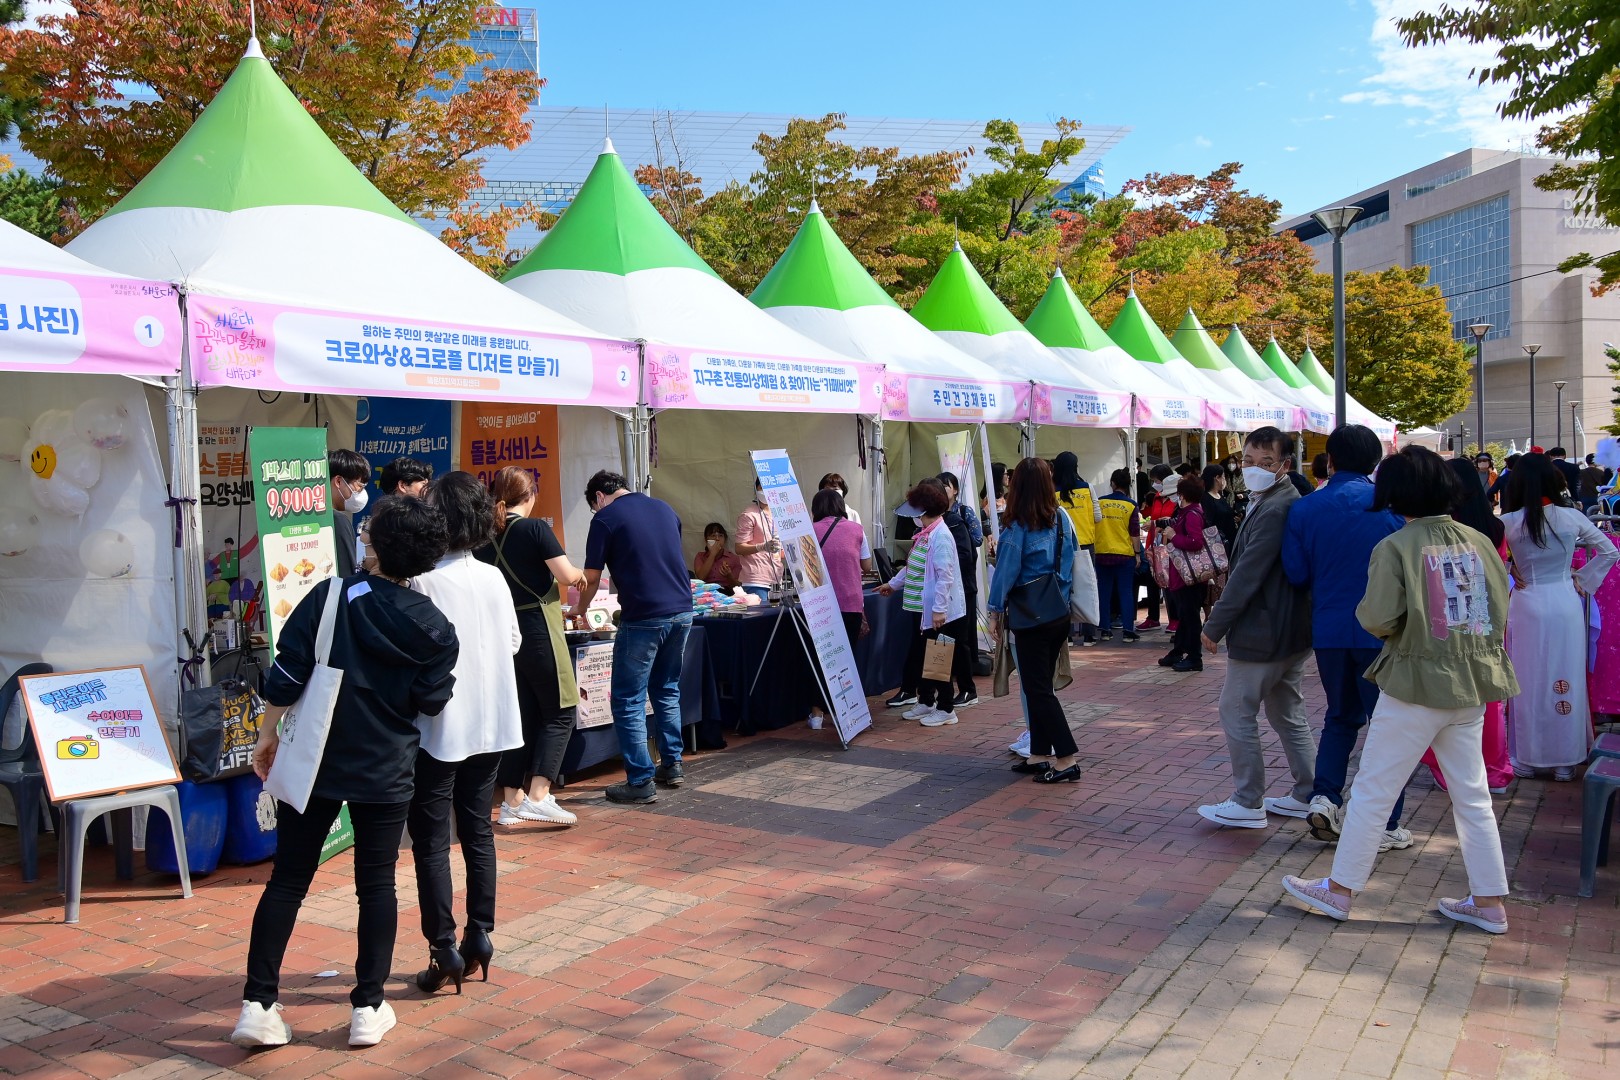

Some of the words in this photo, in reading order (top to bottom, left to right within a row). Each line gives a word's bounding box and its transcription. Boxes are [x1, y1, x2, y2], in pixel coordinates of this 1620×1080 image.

[18, 305, 79, 335] 사진)
[145, 323, 153, 338] 1
[215, 311, 254, 329] 해운대
[362, 325, 391, 338] 일하는
[394, 328, 421, 341] 주민의
[424, 331, 460, 345] 햇살같은
[462, 335, 487, 347] 미래를
[489, 337, 532, 351] 응원합니다.
[325, 340, 462, 371] 크로와상&크로플
[468, 352, 512, 374] 디저트
[518, 356, 559, 377] 만들기
[621, 371, 626, 381] 2
[694, 369, 723, 387] 지구촌
[724, 371, 778, 390] 전통의상체험
[780, 376, 788, 390] &
[876, 386, 881, 394] 3
[359, 440, 406, 454] 사회복지사가
[407, 436, 448, 455] 함께합니다
[471, 436, 548, 465] 돌봄서비스
[261, 459, 302, 482] 1박스에
[304, 458, 327, 479] 10개
[200, 480, 255, 506] 요양센
[266, 484, 327, 518] 9,900원
[39, 679, 106, 706] 폴라로이드
[53, 690, 107, 713] 사진찍기
[87, 710, 143, 722] 수어이름
[98, 726, 140, 739] 만들기
[220, 751, 254, 771] LIFE
